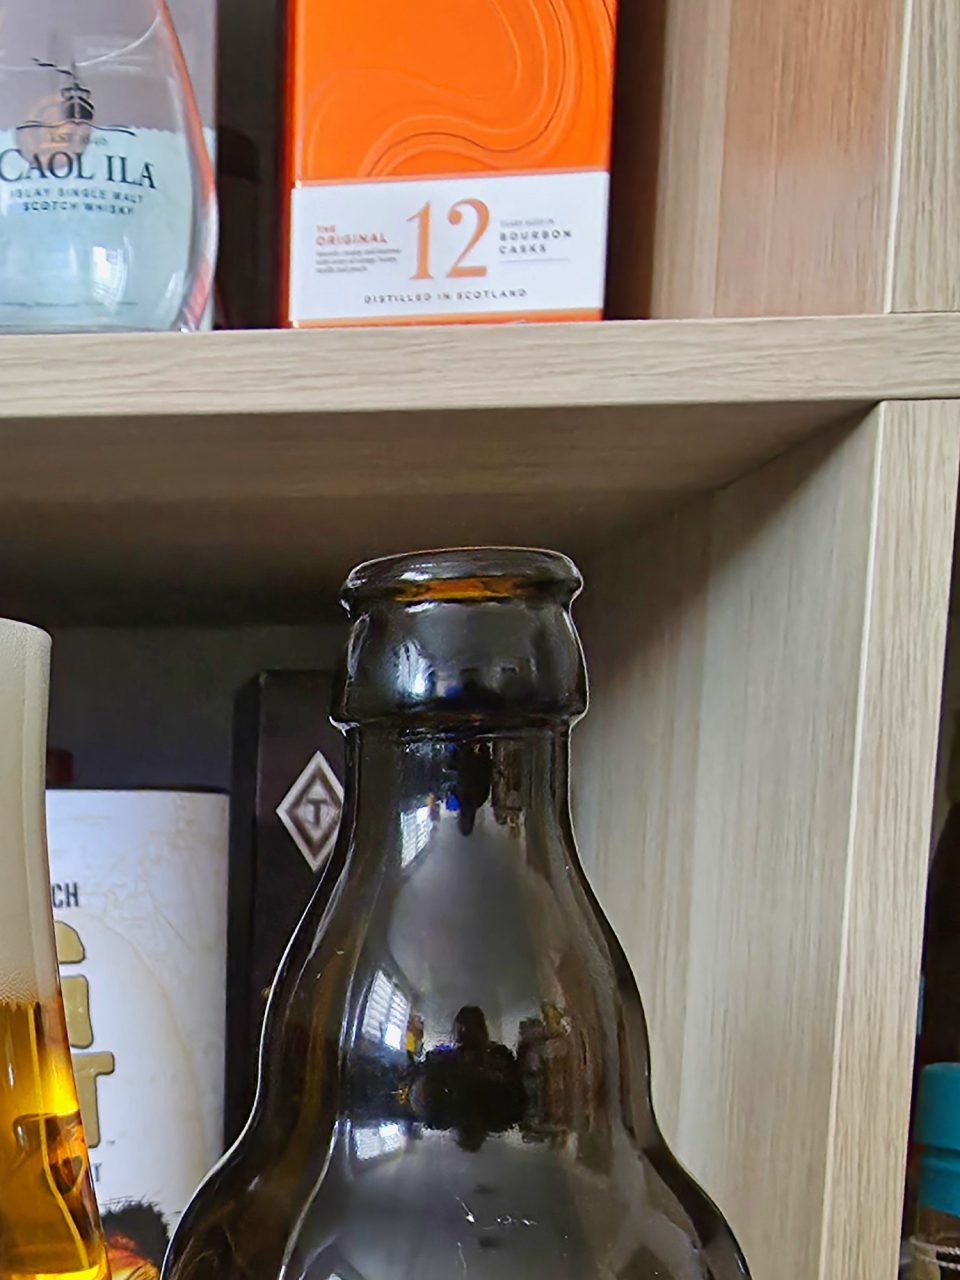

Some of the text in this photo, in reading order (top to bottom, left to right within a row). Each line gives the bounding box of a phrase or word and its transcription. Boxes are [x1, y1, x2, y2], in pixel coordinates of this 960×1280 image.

[106, 155, 157, 190] ILA
[57, 188, 106, 200] SINGLE
[22, 201, 77, 212] SCOTCH
[316, 233, 387, 246] ORIGINAL
[406, 197, 491, 281] 12
[499, 229, 572, 242] BOURBON
[498, 243, 547, 255] CASKS
[364, 288, 528, 304] DISTILLED IN SCOTLAND
